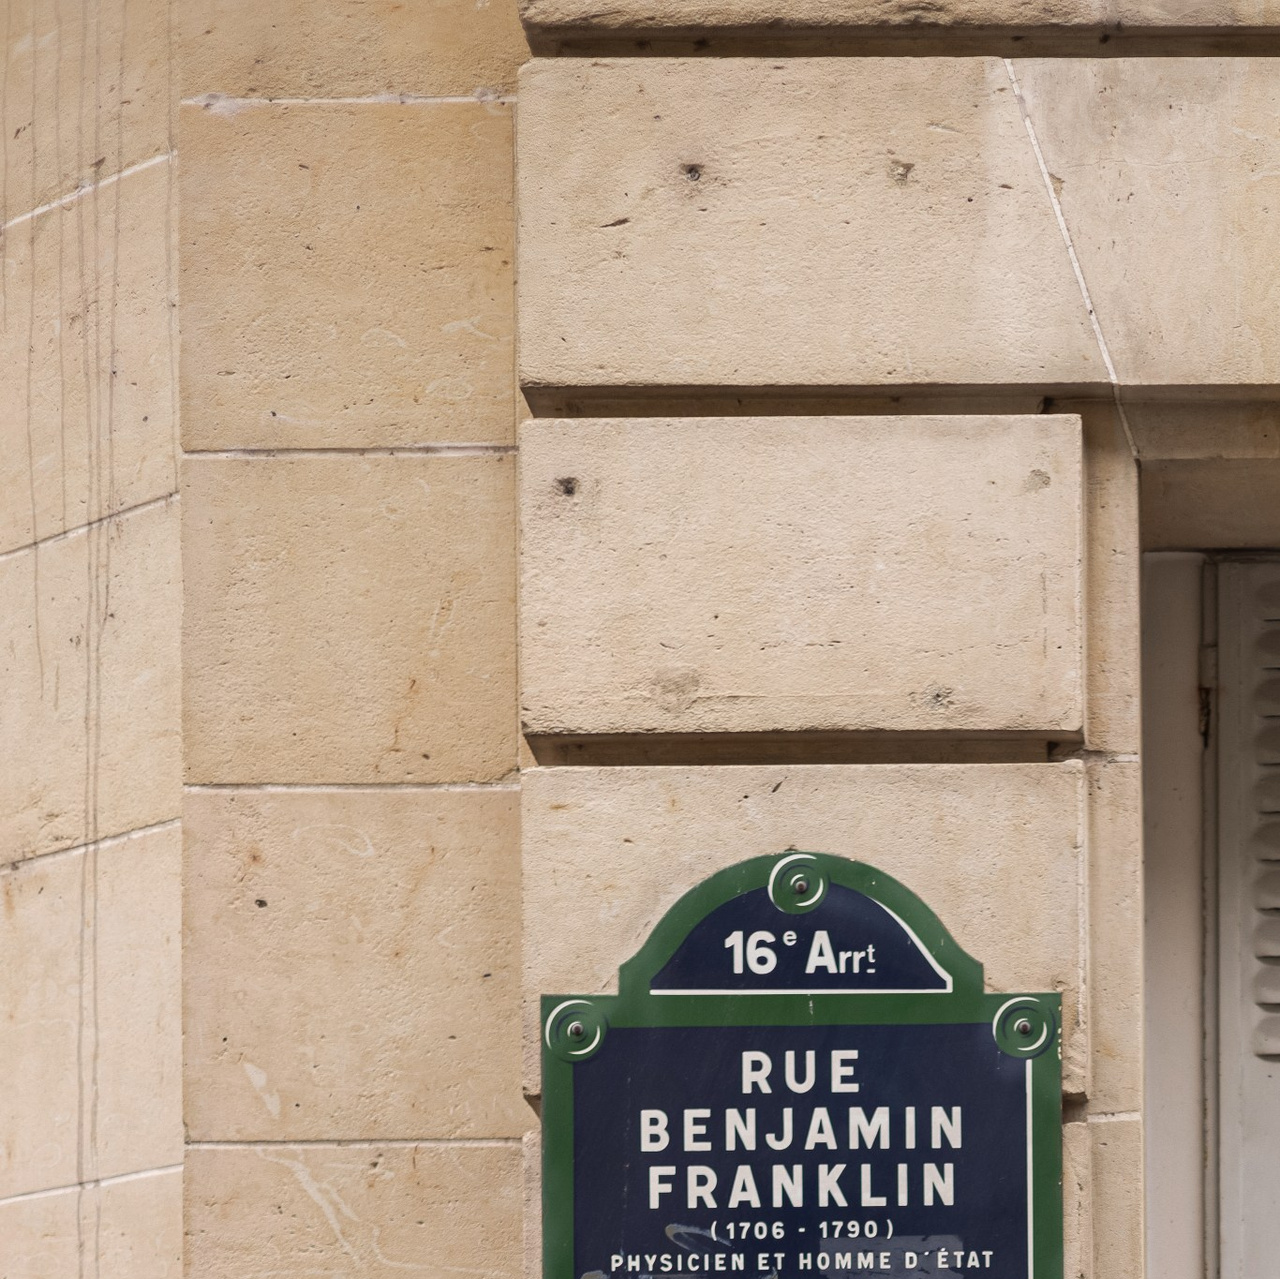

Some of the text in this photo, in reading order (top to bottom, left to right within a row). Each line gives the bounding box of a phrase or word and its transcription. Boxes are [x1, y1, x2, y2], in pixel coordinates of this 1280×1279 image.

[741, 1050, 859, 1093] RUE
[639, 1106, 961, 1152] BENJAMIN
[648, 1163, 954, 1209] FRANKLIN
[610, 1252, 745, 1272] PHYSICIEN
[757, 1252, 785, 1271] ET
[798, 1251, 891, 1271] HOMME
